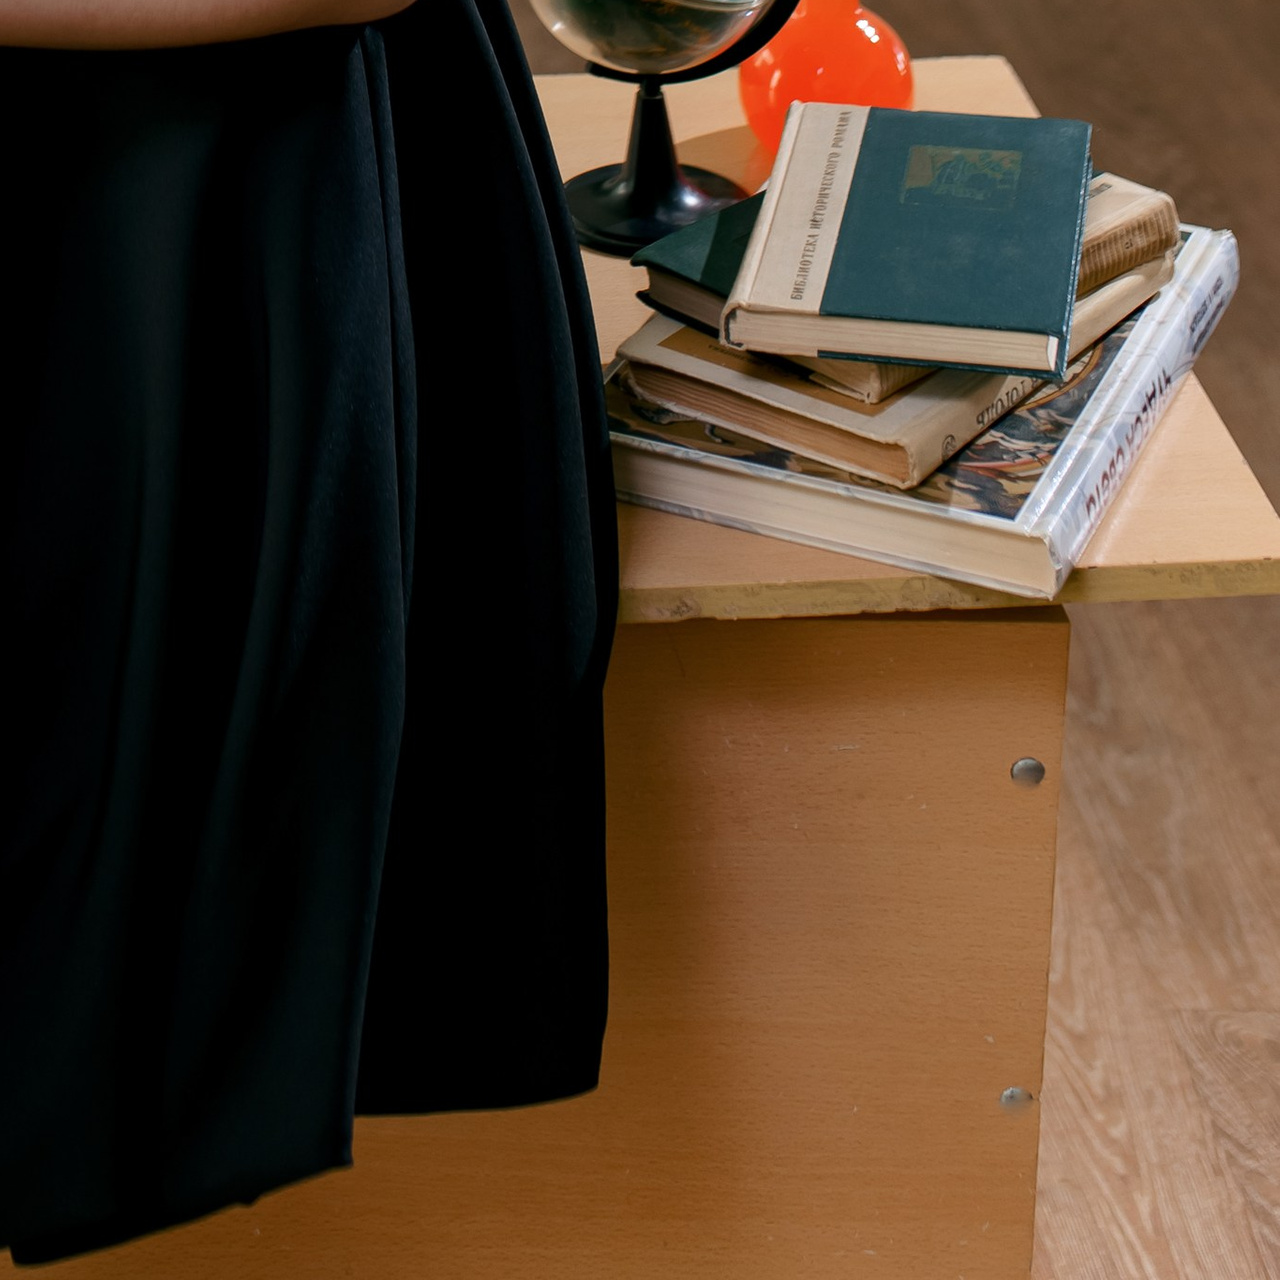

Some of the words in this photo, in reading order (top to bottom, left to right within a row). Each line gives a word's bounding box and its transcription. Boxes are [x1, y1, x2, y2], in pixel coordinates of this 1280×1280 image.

[790, 234, 819, 301] БИБЛИОТЕКА
[810, 152, 841, 230] ИСТОРИЧЕСКОГО
[831, 110, 852, 149] РОМАНА
